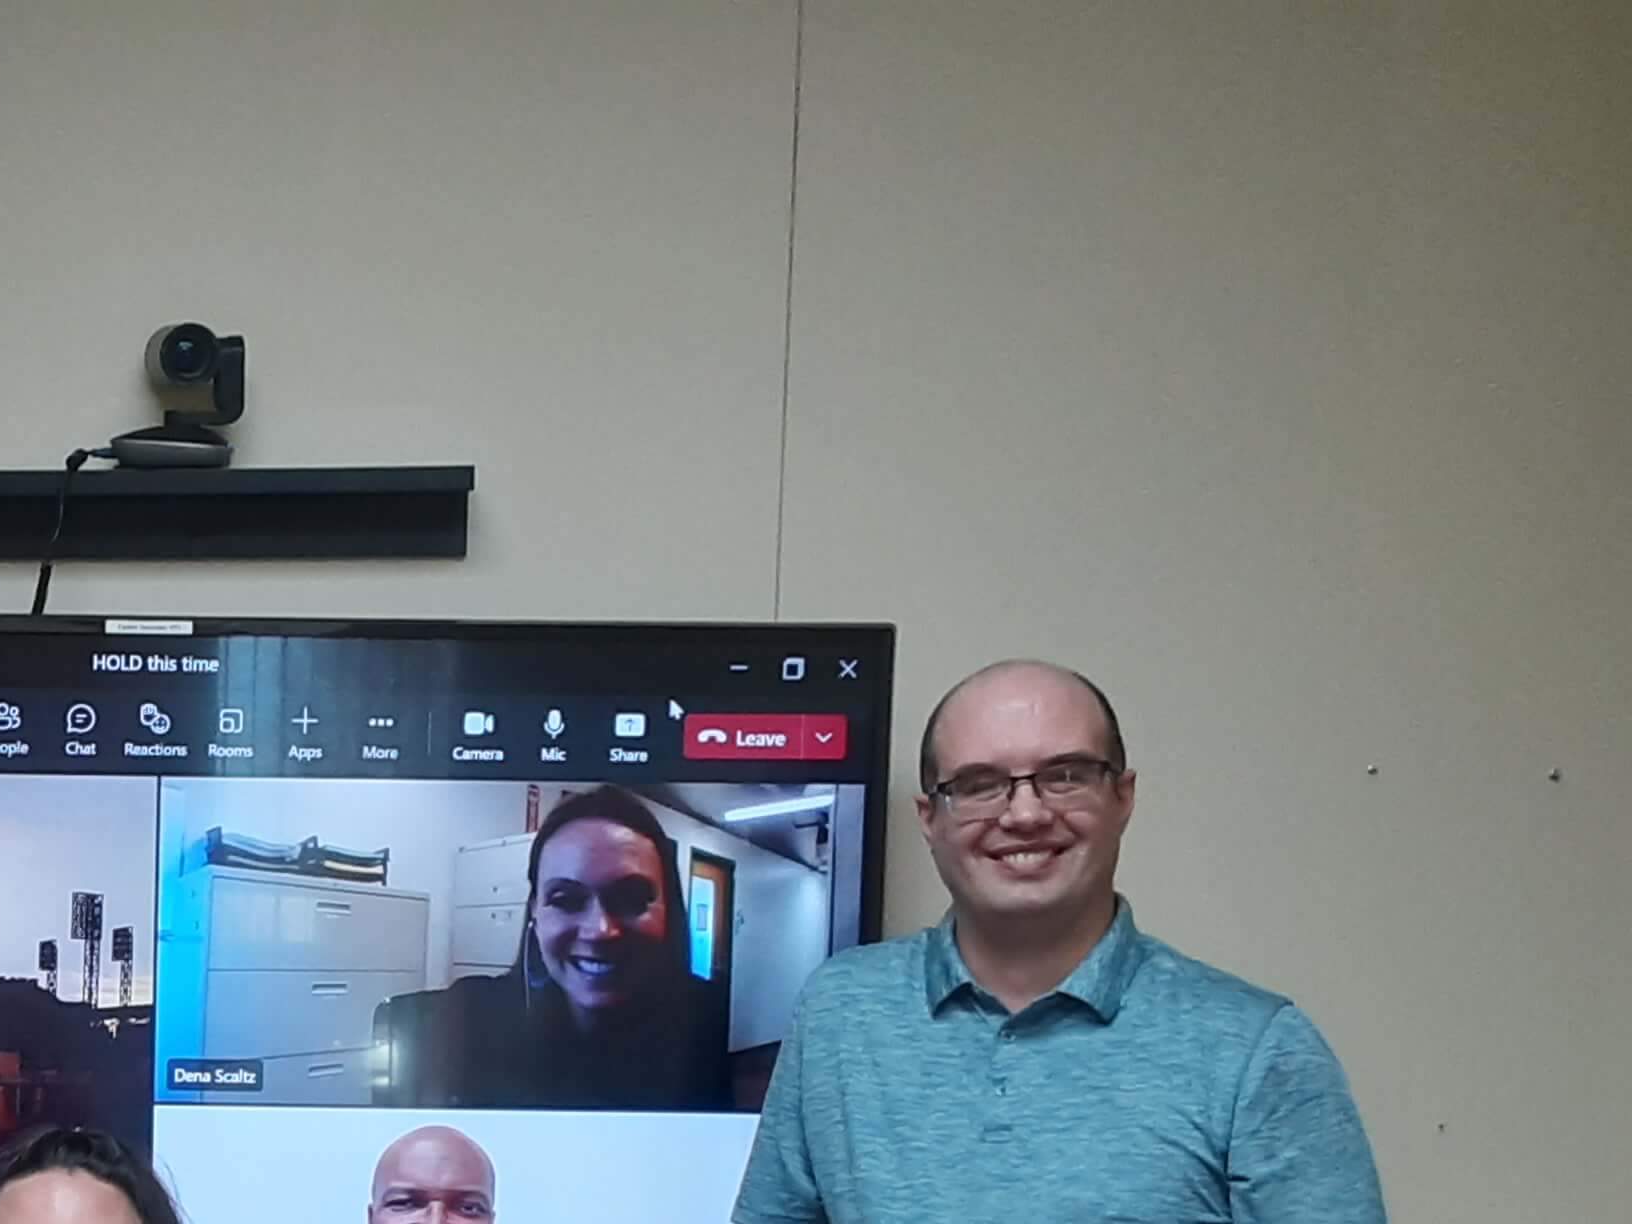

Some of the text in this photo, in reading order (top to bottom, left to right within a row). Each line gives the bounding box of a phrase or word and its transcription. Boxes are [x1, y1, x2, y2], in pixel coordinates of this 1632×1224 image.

[92, 654, 219, 673] HOLD this time
[735, 730, 787, 747] Leave
[65, 741, 97, 756] Chat
[124, 742, 188, 757] Reactions
[207, 744, 254, 759] Rooms
[287, 745, 323, 761] Apps
[362, 746, 399, 761] More
[452, 747, 504, 761] Camera
[540, 747, 567, 762] Mic
[609, 748, 649, 763] Share
[174, 1068, 257, 1084] Dena Scaltz
